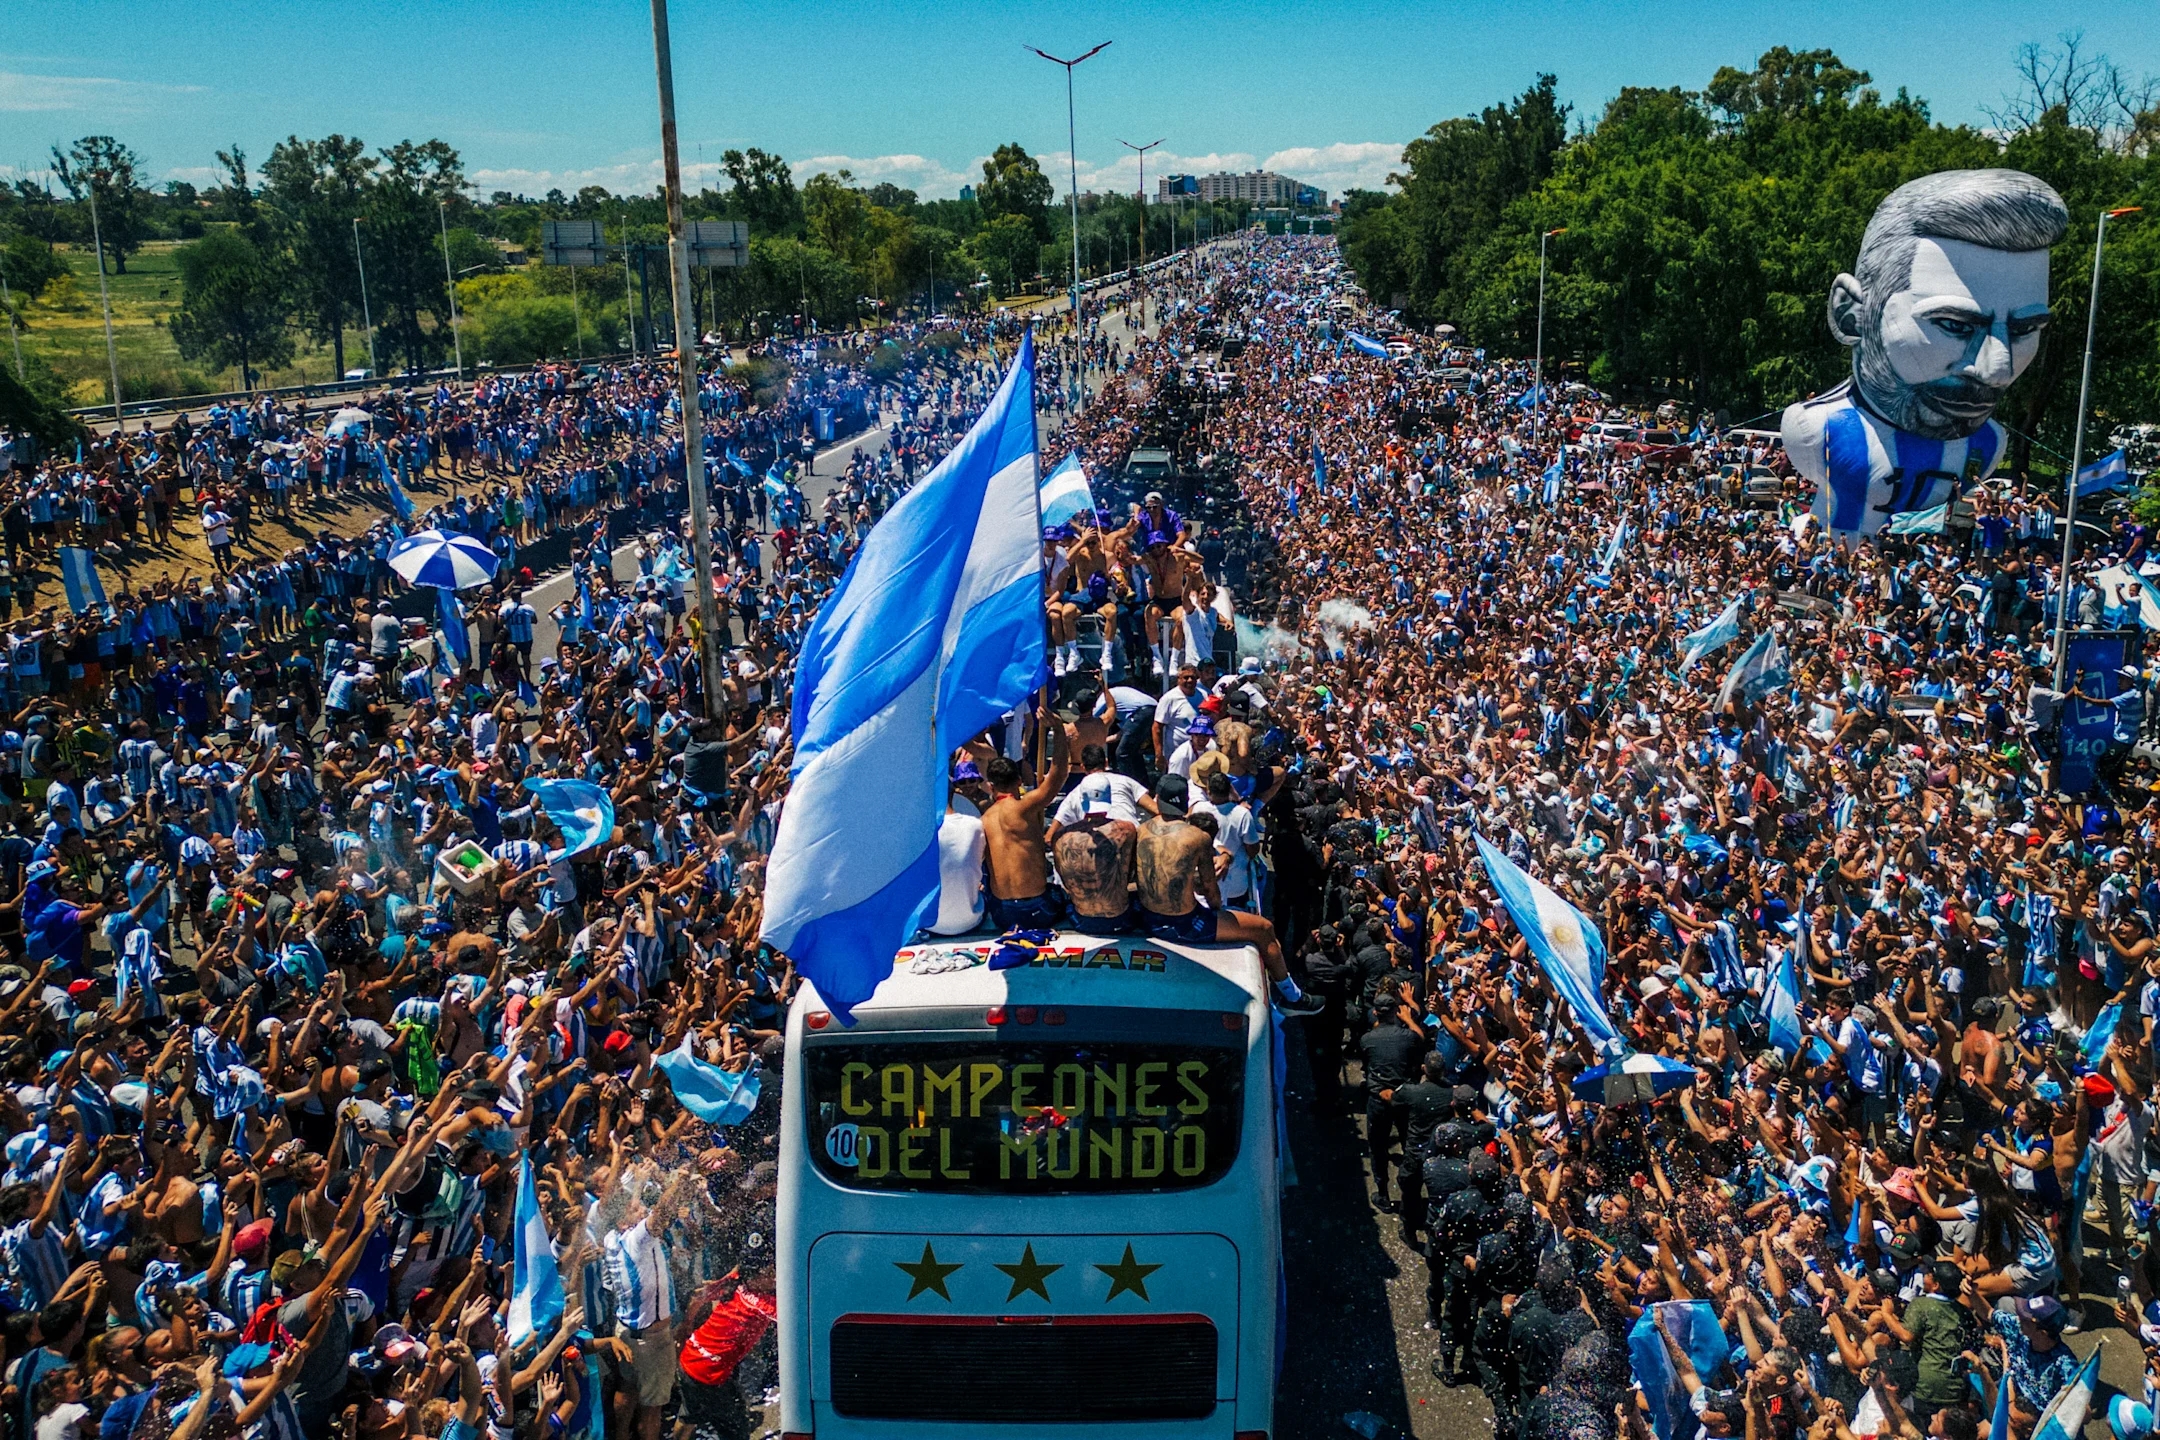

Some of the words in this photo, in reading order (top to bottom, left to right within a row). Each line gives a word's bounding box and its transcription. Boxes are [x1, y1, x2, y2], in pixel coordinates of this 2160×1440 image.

[129, 755, 142, 769] 10
[2064, 738, 2107, 756] 140
[841, 1062, 1209, 1117] CAMPEONES
[858, 1126, 970, 1179] DEL
[1000, 1125, 1206, 1179] MUNDO
